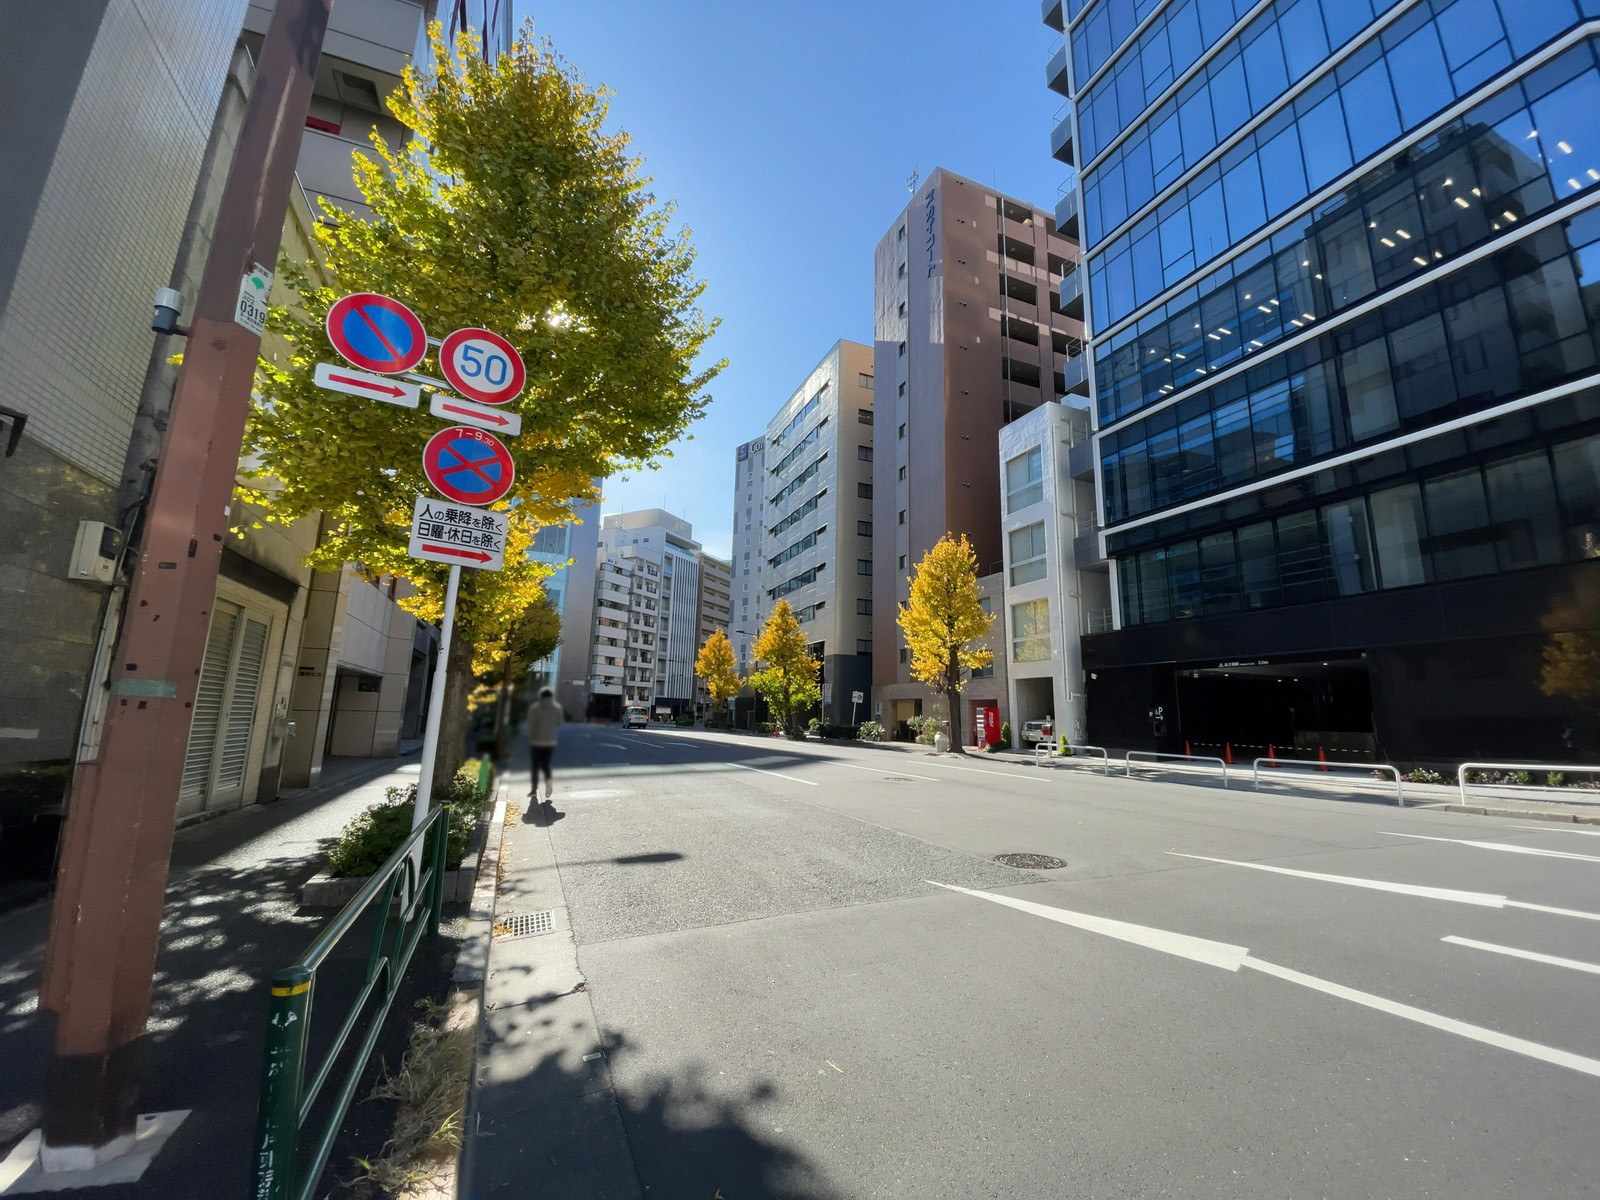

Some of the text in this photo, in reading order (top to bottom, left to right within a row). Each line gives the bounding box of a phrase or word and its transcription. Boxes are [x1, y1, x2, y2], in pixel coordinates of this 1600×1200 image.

[240, 300, 265, 324] 0319
[460, 344, 507, 386] 50
[419, 504, 503, 533] 人の乗降を除く
